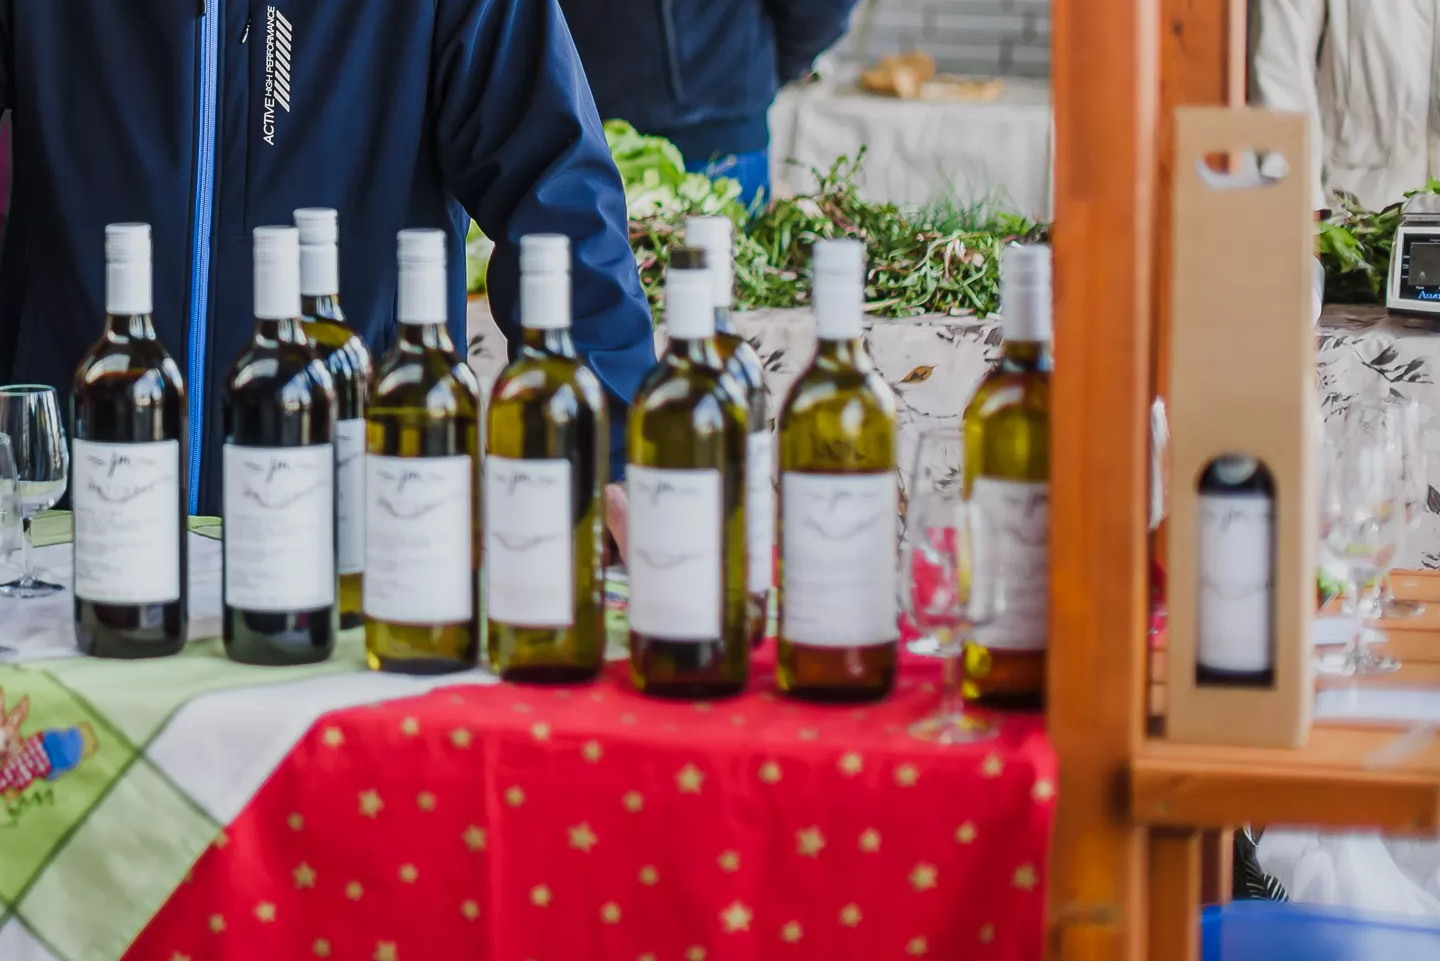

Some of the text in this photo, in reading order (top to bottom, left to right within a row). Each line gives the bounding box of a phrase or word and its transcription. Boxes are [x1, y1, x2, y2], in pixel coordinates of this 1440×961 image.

[263, 5, 276, 145] ACTIVE HIGH PERFORMANCE
